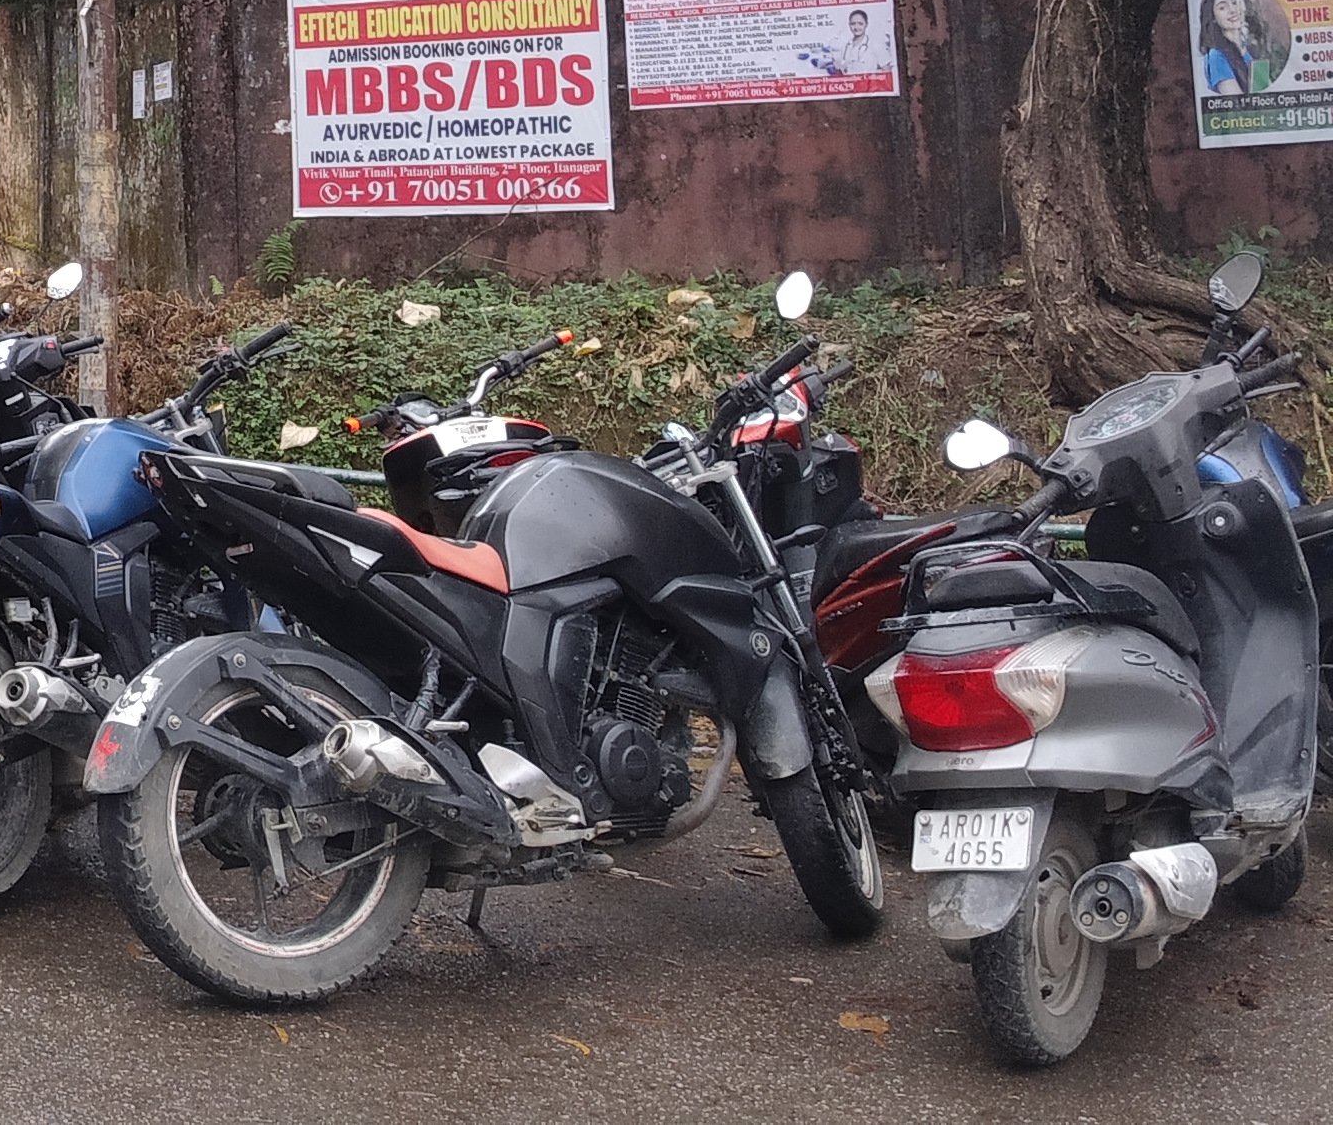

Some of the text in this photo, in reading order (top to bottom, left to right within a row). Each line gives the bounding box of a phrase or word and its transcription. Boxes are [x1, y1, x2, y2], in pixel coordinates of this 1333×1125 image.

[299, 10, 361, 43] EFTECH
[366, 2, 464, 39] EDUCATION
[1292, 7, 1331, 24] PUNE
[1303, 31, 1333, 44] MBBS
[328, 36, 564, 64] ADMISSION BOOKING GOING ON FOR
[305, 53, 595, 116] MBBS/BDS
[1302, 69, 1326, 82] BBM
[670, 93, 696, 102] Phone
[781, 85, 799, 95] +91
[1208, 99, 1233, 110] Office
[1252, 97, 1276, 107] Floor,
[1277, 95, 1297, 107] Opp.
[1299, 92, 1321, 103] Hotel
[323, 121, 423, 141] AYURVEDIC
[437, 115, 572, 139] HOMEOPATHIC
[1210, 115, 1267, 130] Contact
[310, 142, 595, 164] INDIA & ABROAD AT LOWEST PACKAGE
[303, 168, 330, 180] Vivik
[332, 167, 361, 179] Vihar
[399, 165, 448, 179] Patanjali
[450, 163, 499, 178] Building,
[501, 163, 517, 176] 2nd
[519, 163, 552, 176] Floor,
[553, 162, 602, 177] Itanagar
[344, 175, 582, 204] +91 70051 00366
[939, 812, 1015, 839] AR01K
[944, 841, 1004, 866] 4655
